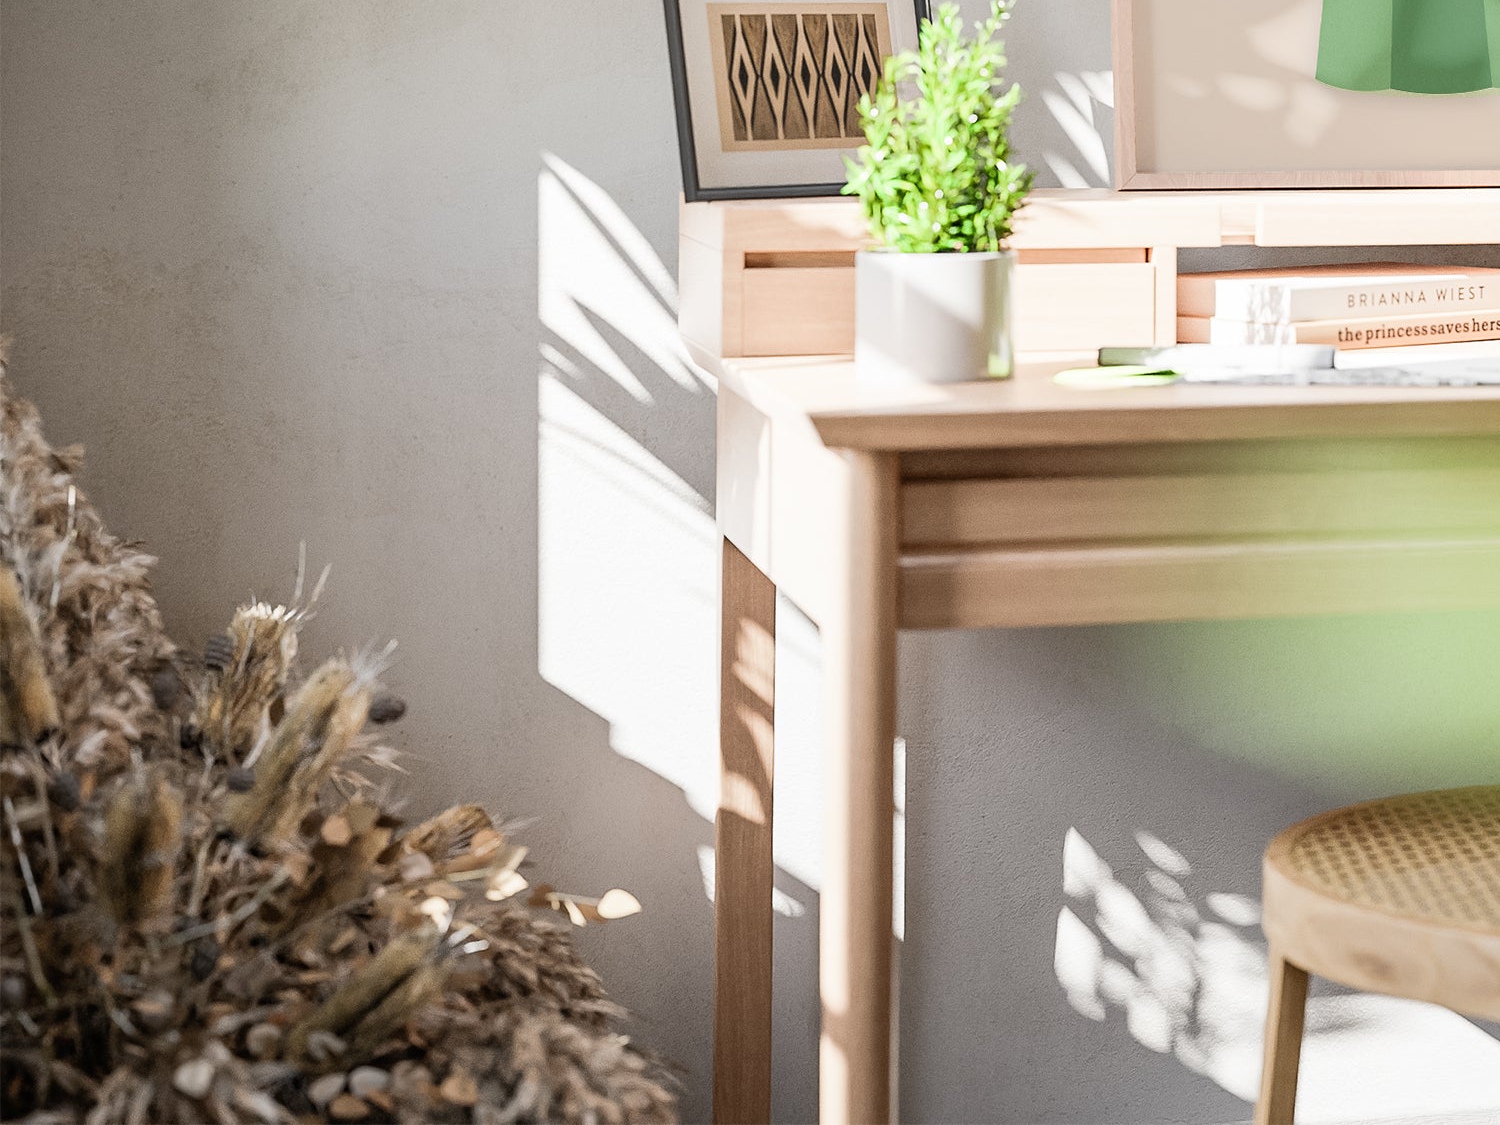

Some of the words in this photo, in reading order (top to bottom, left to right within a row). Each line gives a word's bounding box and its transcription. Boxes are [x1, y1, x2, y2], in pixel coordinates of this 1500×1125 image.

[1347, 291, 1427, 308] BRIANNA
[1435, 286, 1486, 301] WIEST
[1338, 328, 1362, 342] the
[1365, 324, 1428, 344] princess
[1430, 321, 1470, 335] saves
